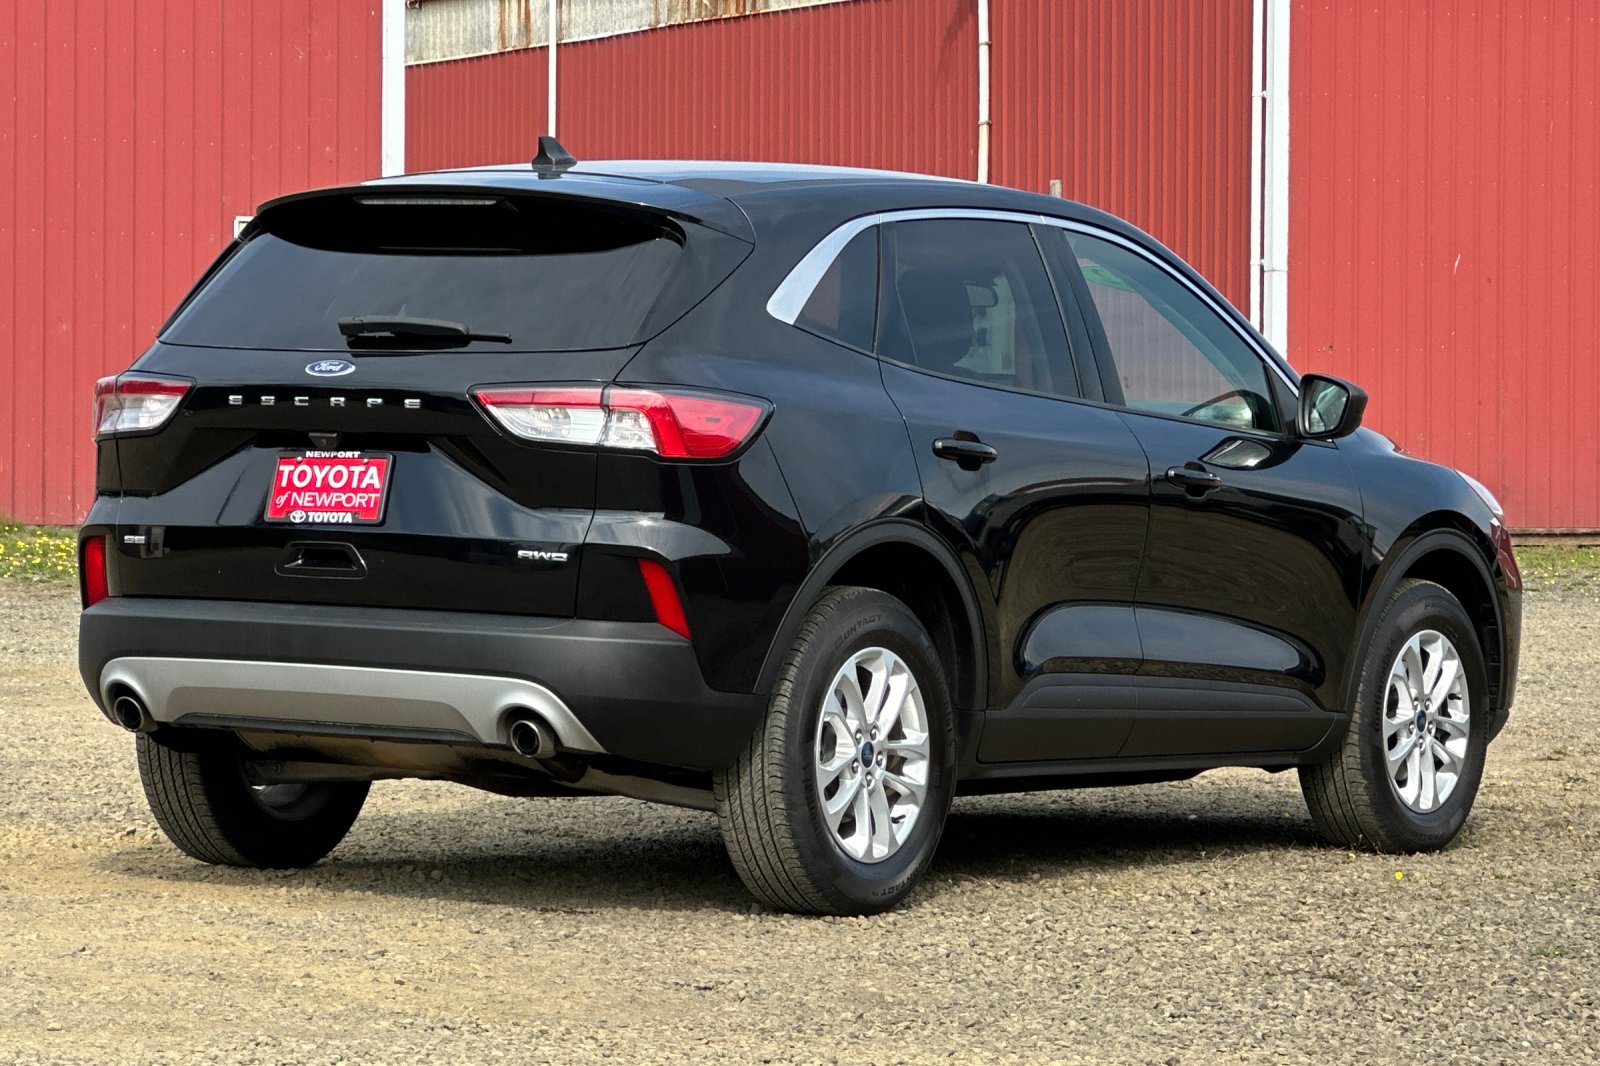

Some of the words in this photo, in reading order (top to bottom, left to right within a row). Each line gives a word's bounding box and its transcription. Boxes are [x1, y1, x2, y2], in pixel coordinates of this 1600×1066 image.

[228, 395, 421, 409] ESCAPE
[305, 450, 361, 458] NEWPORT
[279, 464, 381, 489] TOYOTA
[275, 491, 291, 508] of
[290, 492, 380, 508] NEWPORT
[308, 512, 353, 523] TOYOTA
[124, 535, 145, 544] SE
[517, 550, 568, 561] AWD
